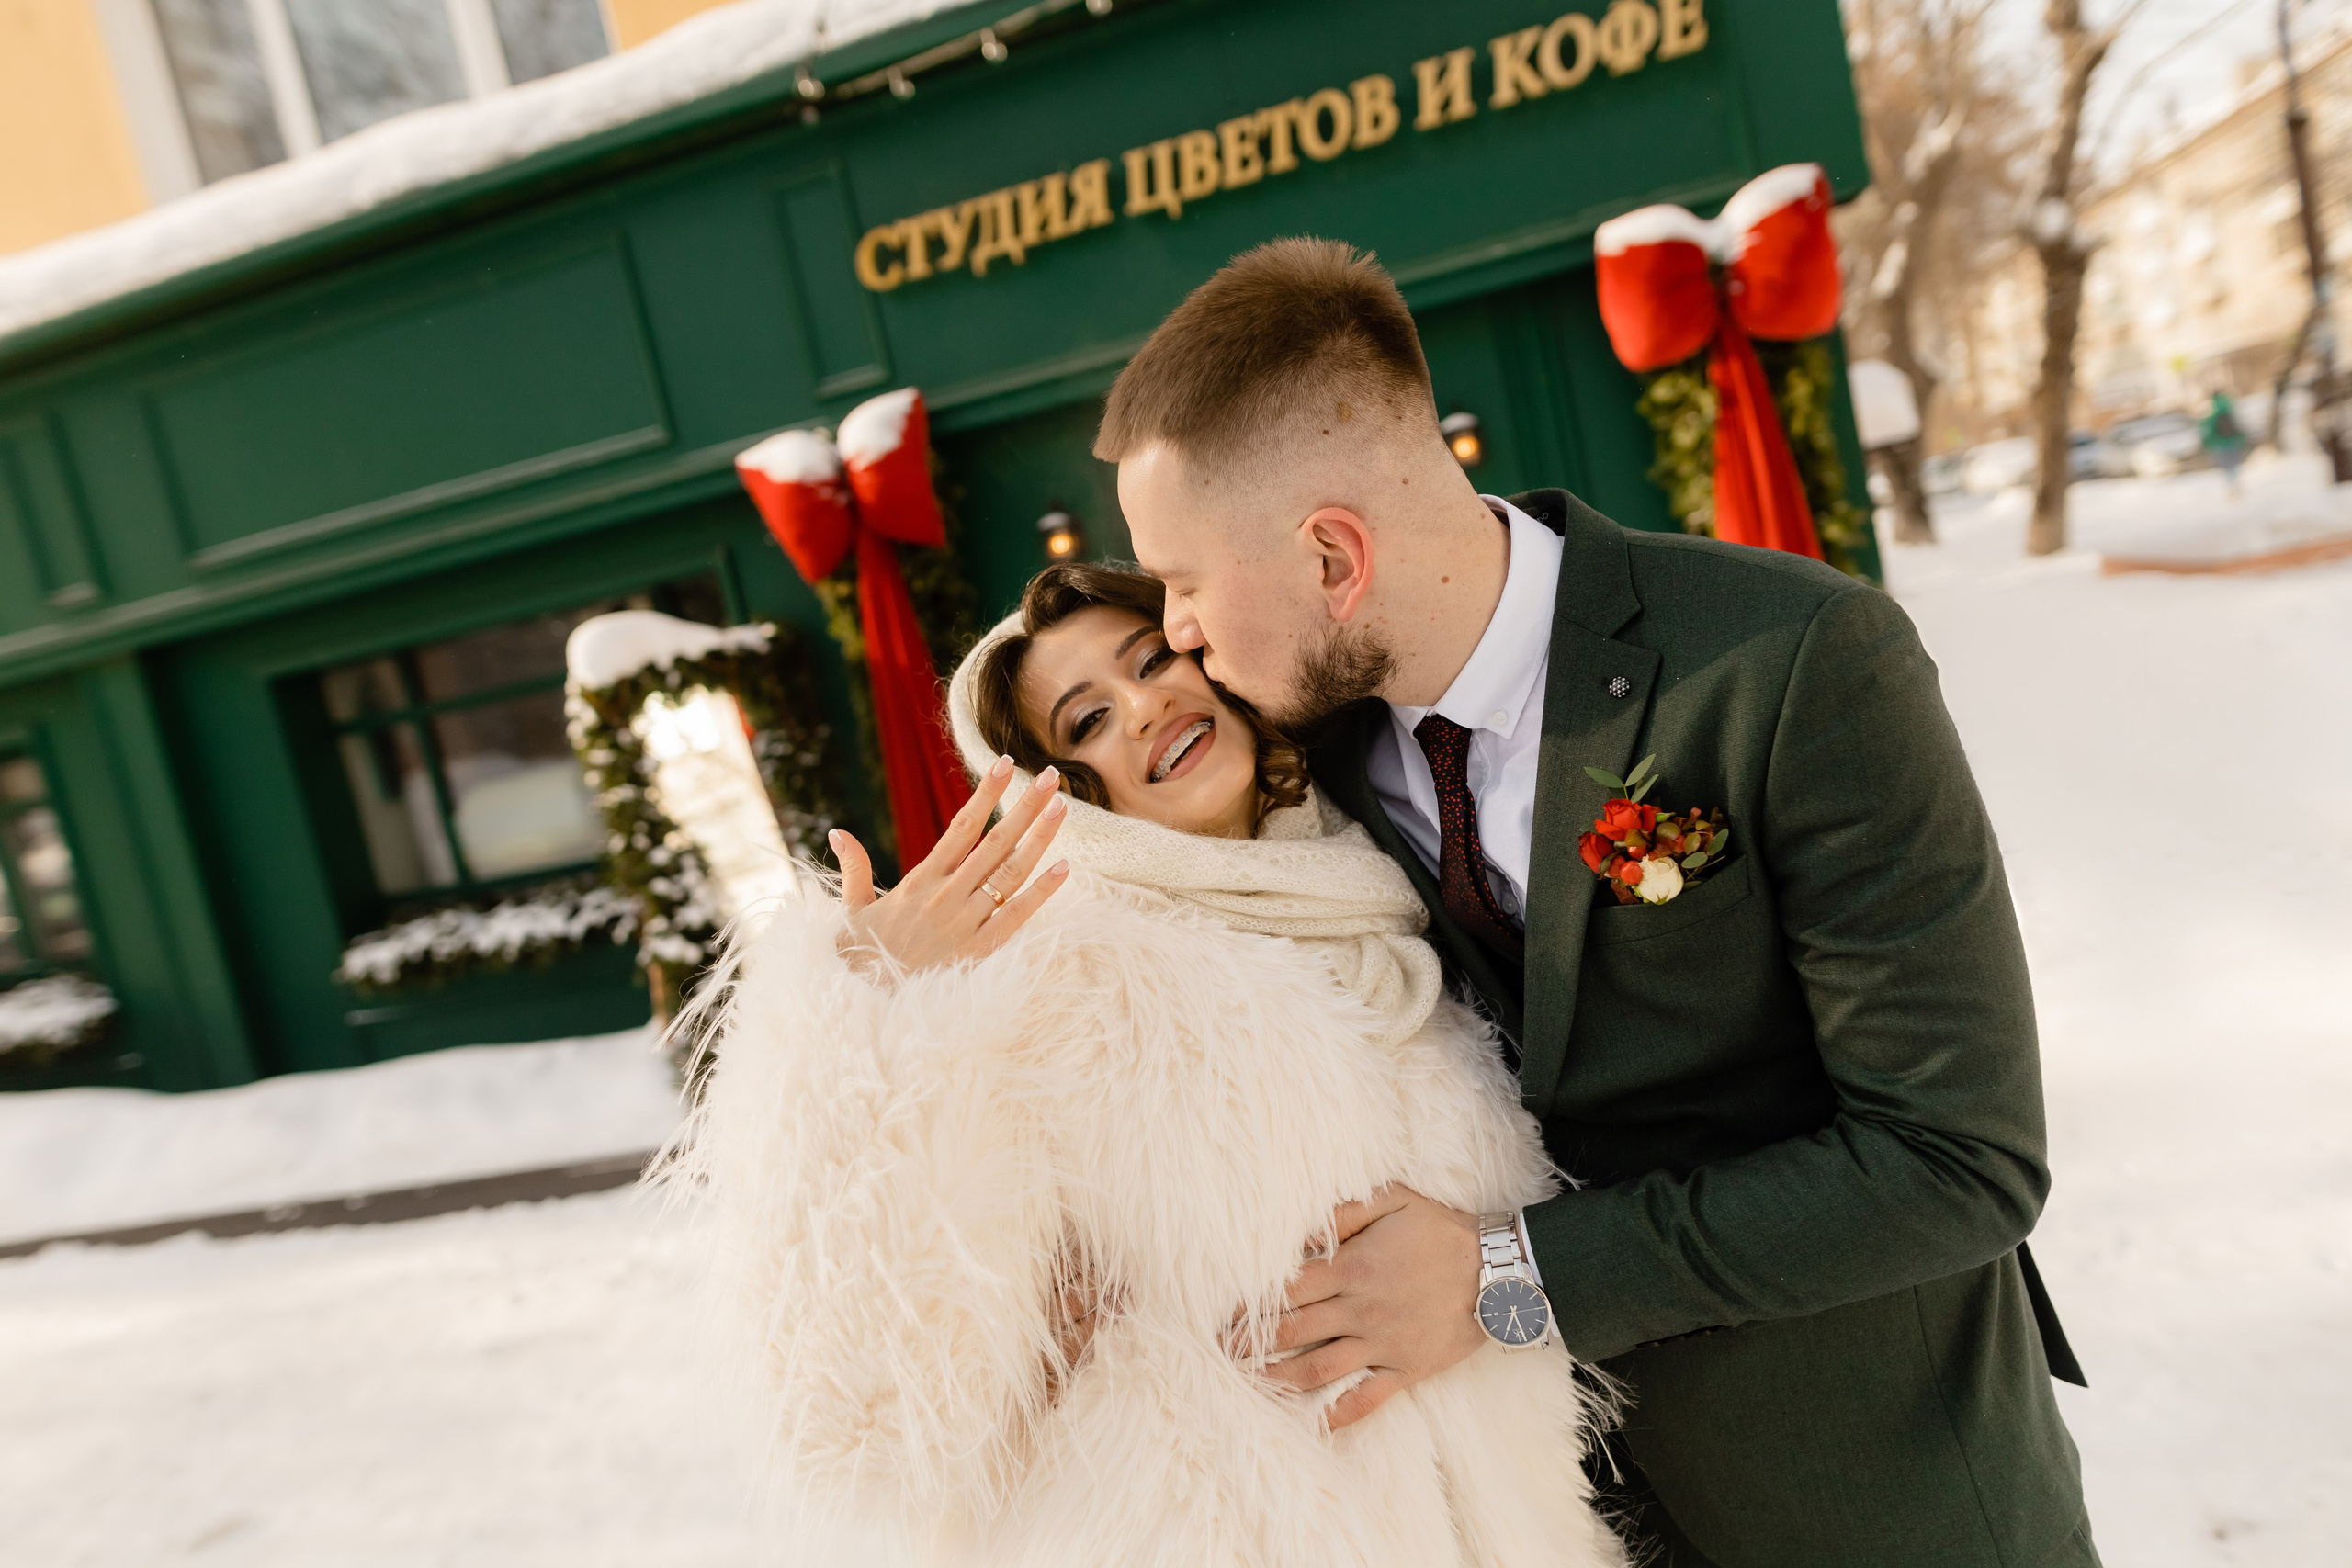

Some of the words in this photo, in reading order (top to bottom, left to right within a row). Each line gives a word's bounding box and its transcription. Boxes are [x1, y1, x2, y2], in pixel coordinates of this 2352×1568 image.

[854, 158, 1114, 292] СТУДИЯ
[1123, 73, 1401, 220] ЦВЕТОВ
[1414, 47, 1476, 130] И
[1489, 0, 1709, 109] КОФЕ
